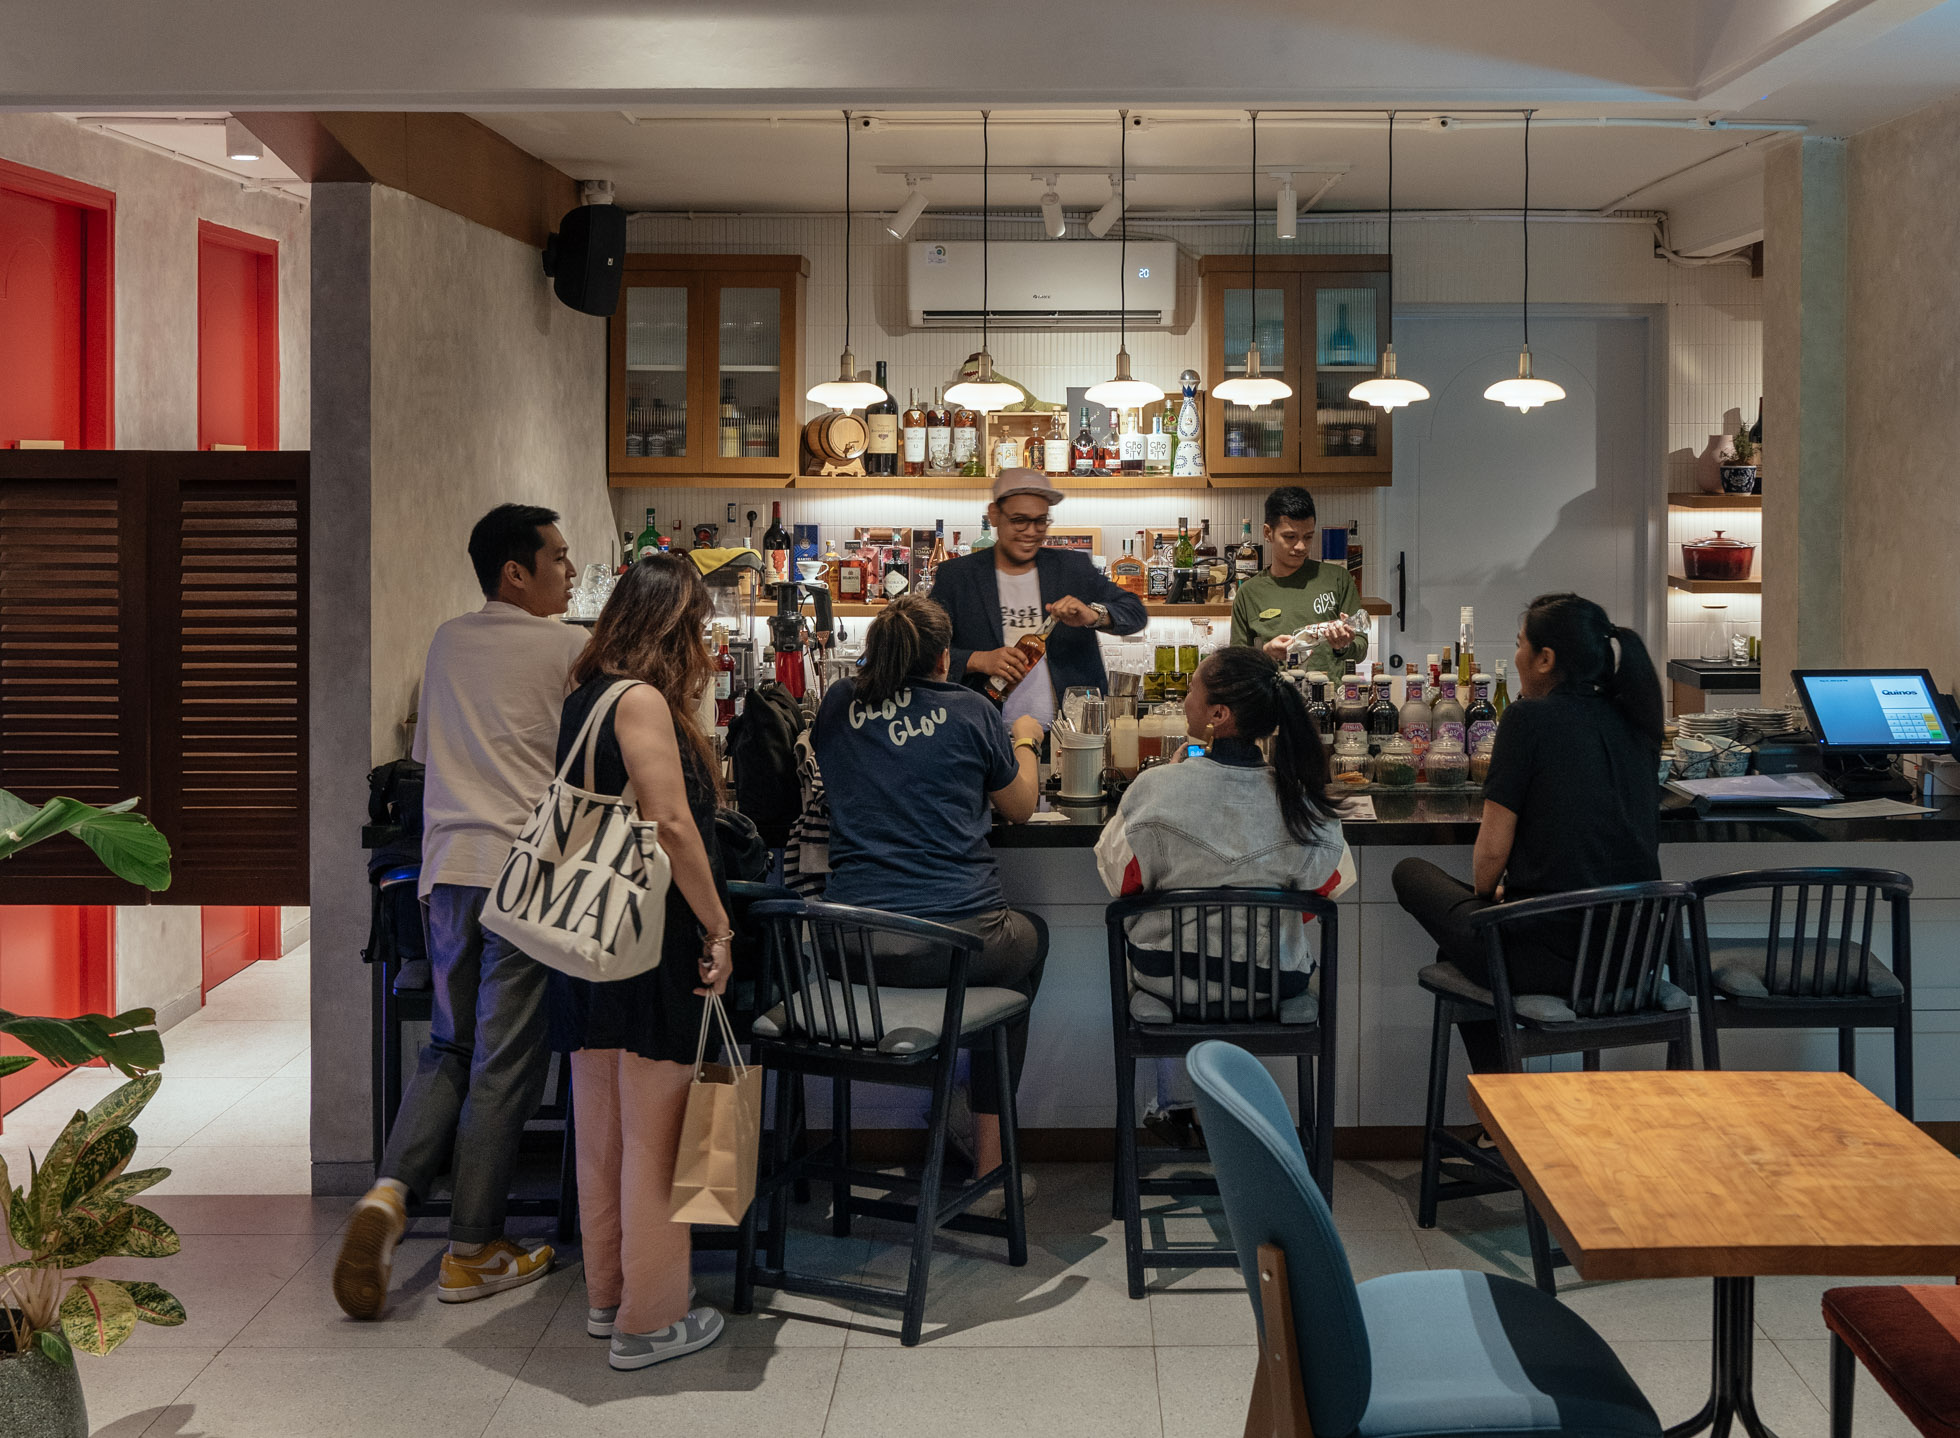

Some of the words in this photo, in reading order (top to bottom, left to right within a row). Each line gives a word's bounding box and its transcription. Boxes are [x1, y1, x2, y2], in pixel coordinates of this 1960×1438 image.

[1139, 268, 1150, 278] 20
[848, 687, 912, 730] GLOU
[888, 707, 947, 746] GLOU
[496, 846, 643, 956] OMAN
